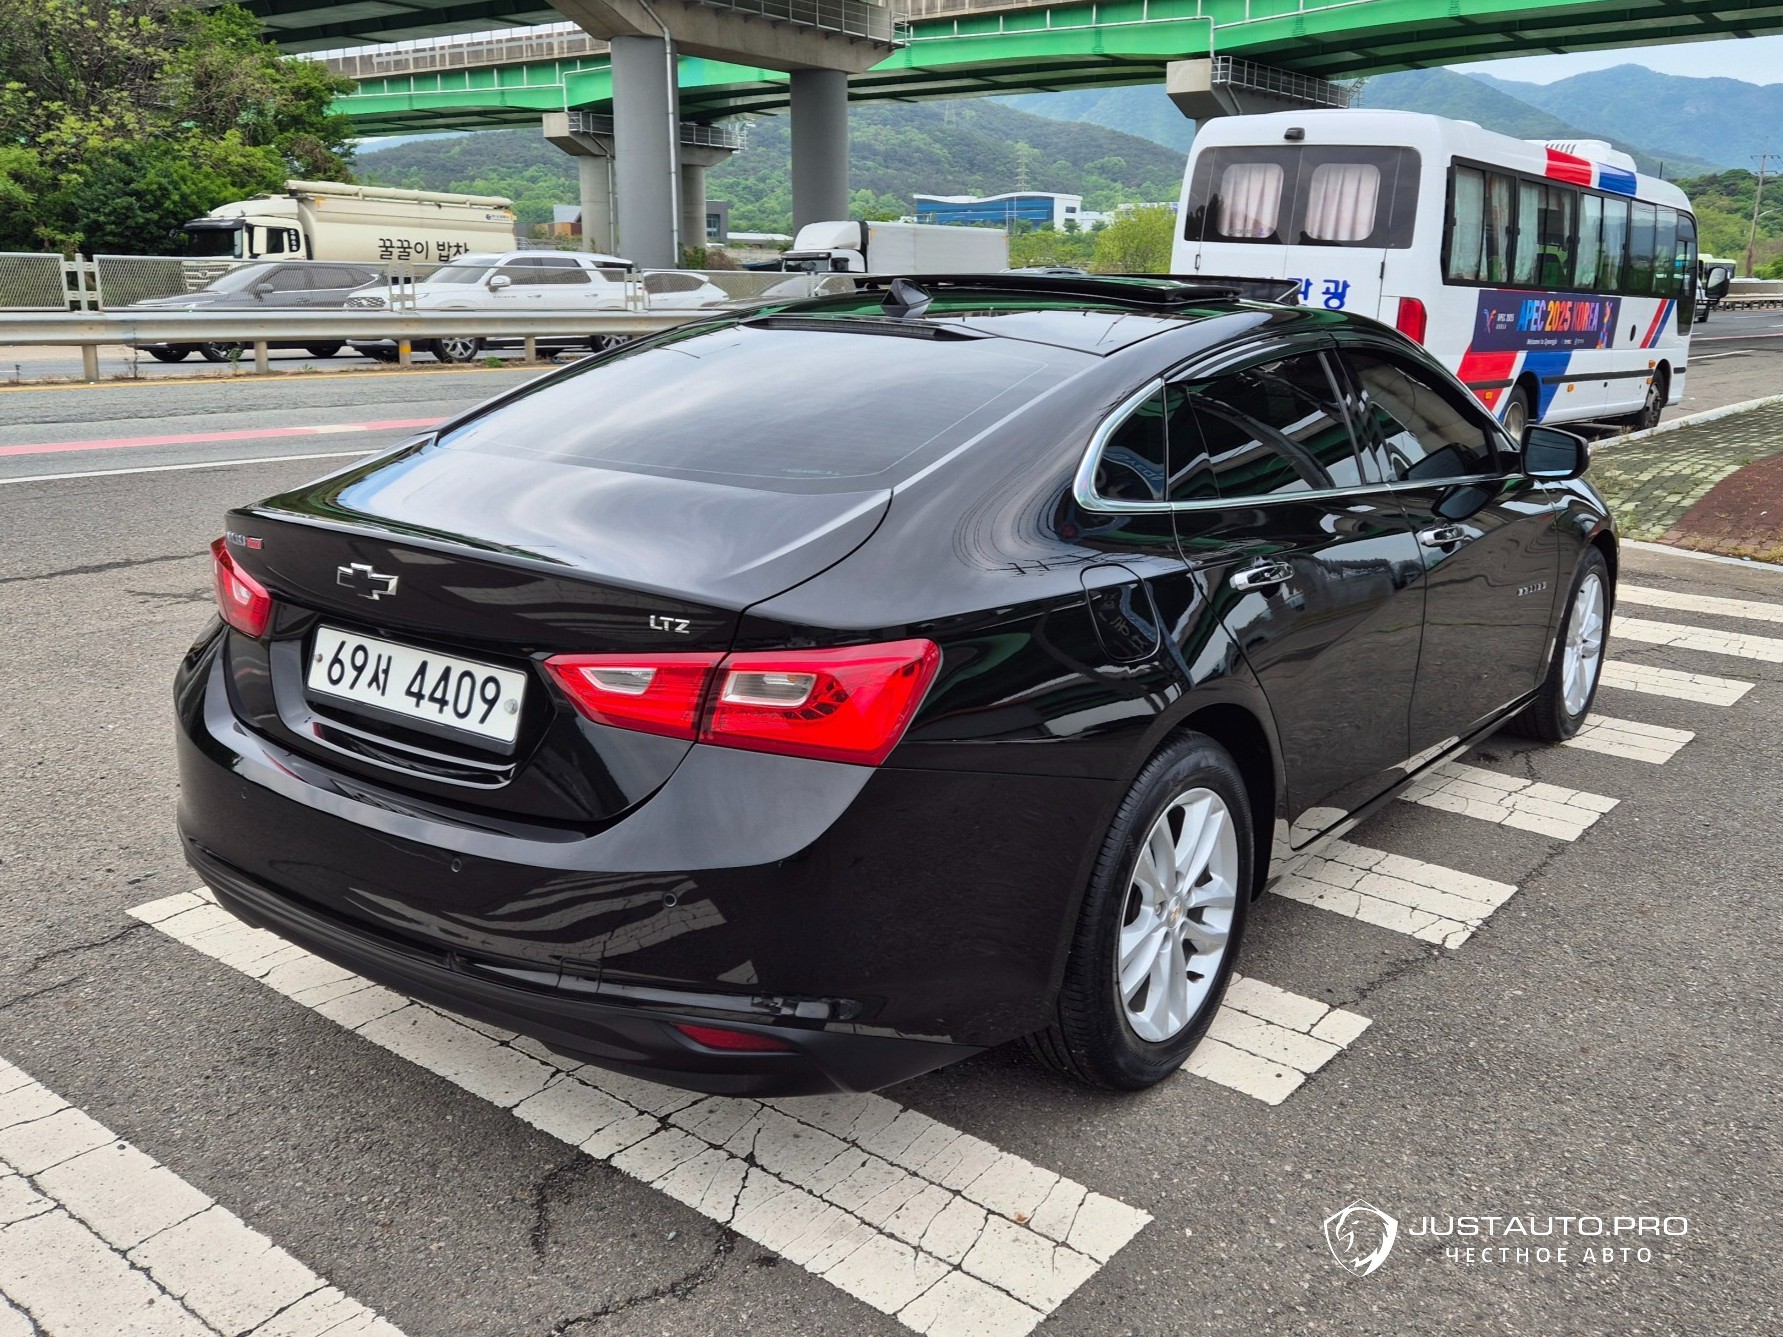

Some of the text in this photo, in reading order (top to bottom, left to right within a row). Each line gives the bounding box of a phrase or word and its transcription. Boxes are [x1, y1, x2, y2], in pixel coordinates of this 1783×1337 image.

[378, 238, 429, 261] 꿀꿀이
[1516, 299, 1600, 332] APEC 2025 KOREA
[650, 614, 690, 634] LTZ
[327, 640, 502, 725] 69서 4409
